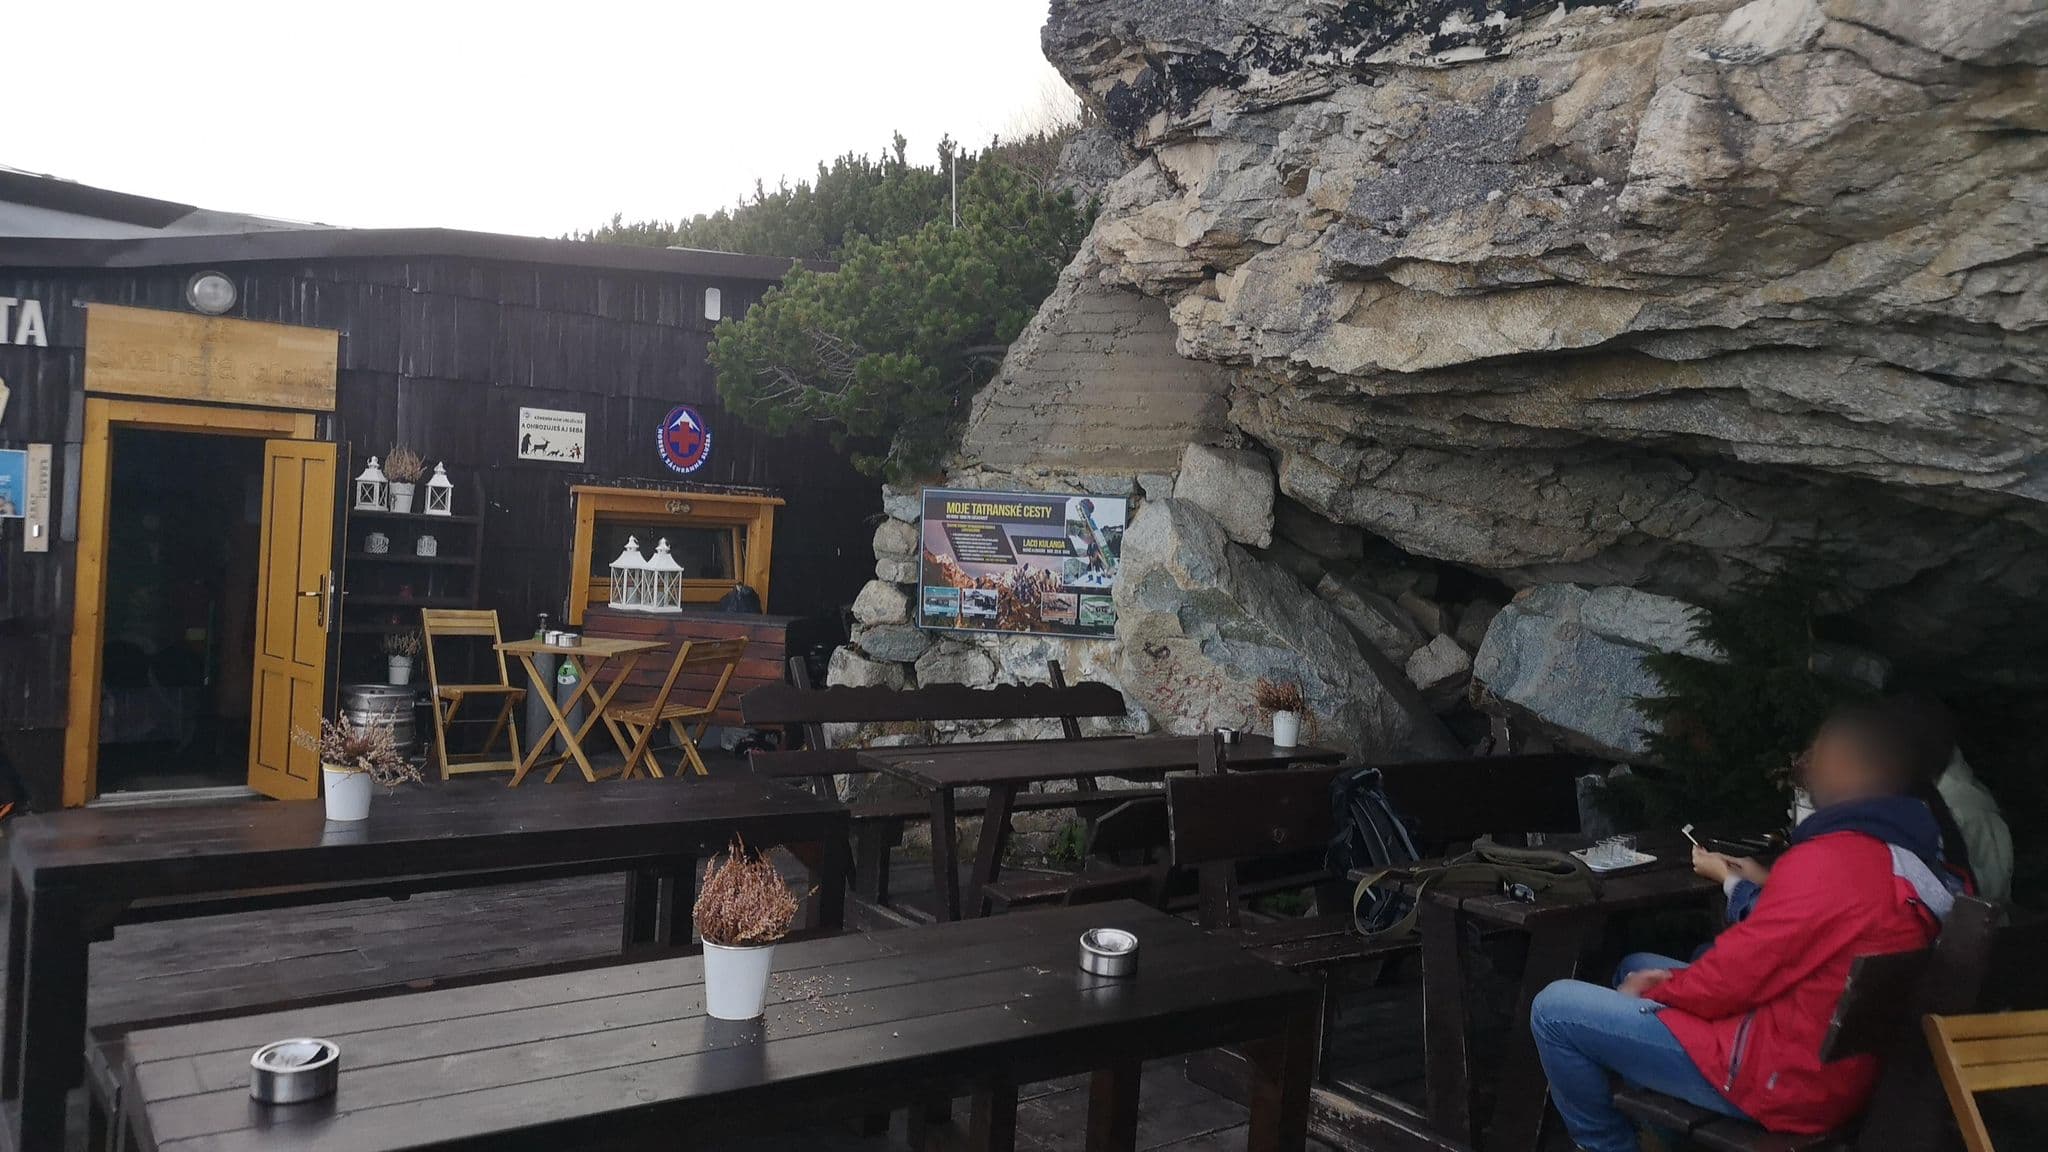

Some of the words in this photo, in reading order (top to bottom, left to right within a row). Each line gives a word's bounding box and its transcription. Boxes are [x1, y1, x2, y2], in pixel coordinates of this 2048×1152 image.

[0, 297, 48, 347] TA
[946, 502, 970, 515] MOJE
[971, 503, 1021, 517] TATRANSKÉ
[1023, 506, 1052, 519] CESTY
[1023, 539, 1037, 548] LACO
